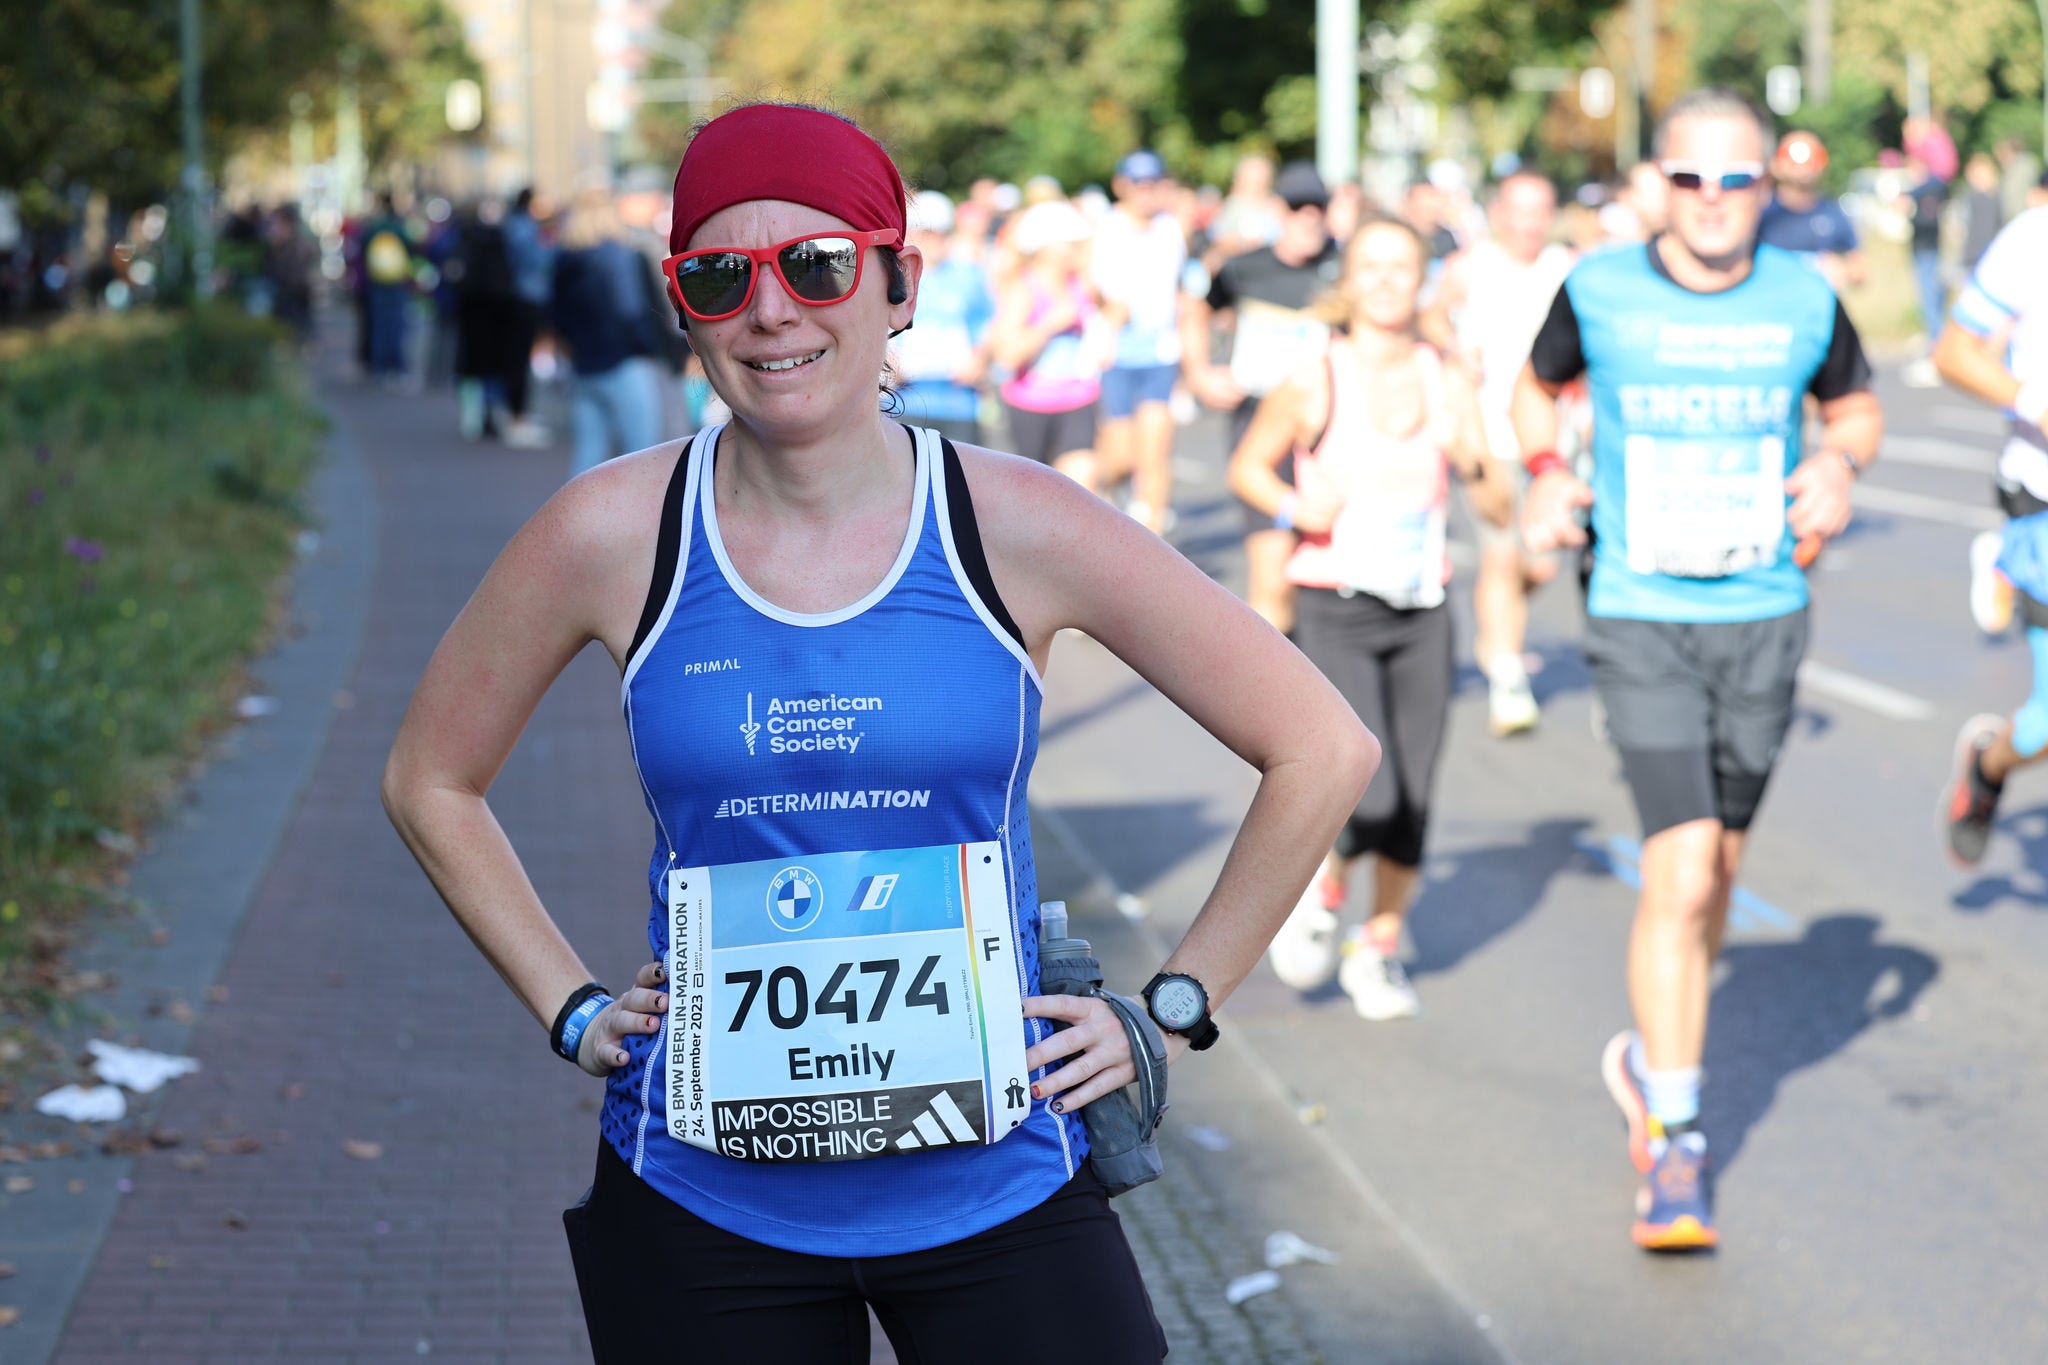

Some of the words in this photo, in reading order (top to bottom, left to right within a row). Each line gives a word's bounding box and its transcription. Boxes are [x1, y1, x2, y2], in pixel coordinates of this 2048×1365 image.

[684, 657, 741, 676] PRIMAL
[767, 693, 883, 716] American
[766, 714, 856, 735] Cancer
[769, 733, 861, 754] Society
[730, 789, 931, 818] DETERMINATION
[773, 869, 815, 890] BMW
[983, 936, 1000, 961] F
[672, 902, 688, 1064] BERLIN-MARATHON
[724, 954, 950, 1033] 70474
[578, 998, 601, 1018] RUN
[690, 994, 703, 1030] 2023
[689, 1032, 704, 1111] September
[788, 1042, 896, 1081] Emily
[672, 1069, 685, 1110] BMW
[673, 1114, 687, 1138] 49.
[690, 1114, 706, 1137] 24.
[717, 1095, 893, 1132] IMPOSSIBLE
[721, 1136, 747, 1159] IS
[752, 1127, 888, 1160] NOTHING
